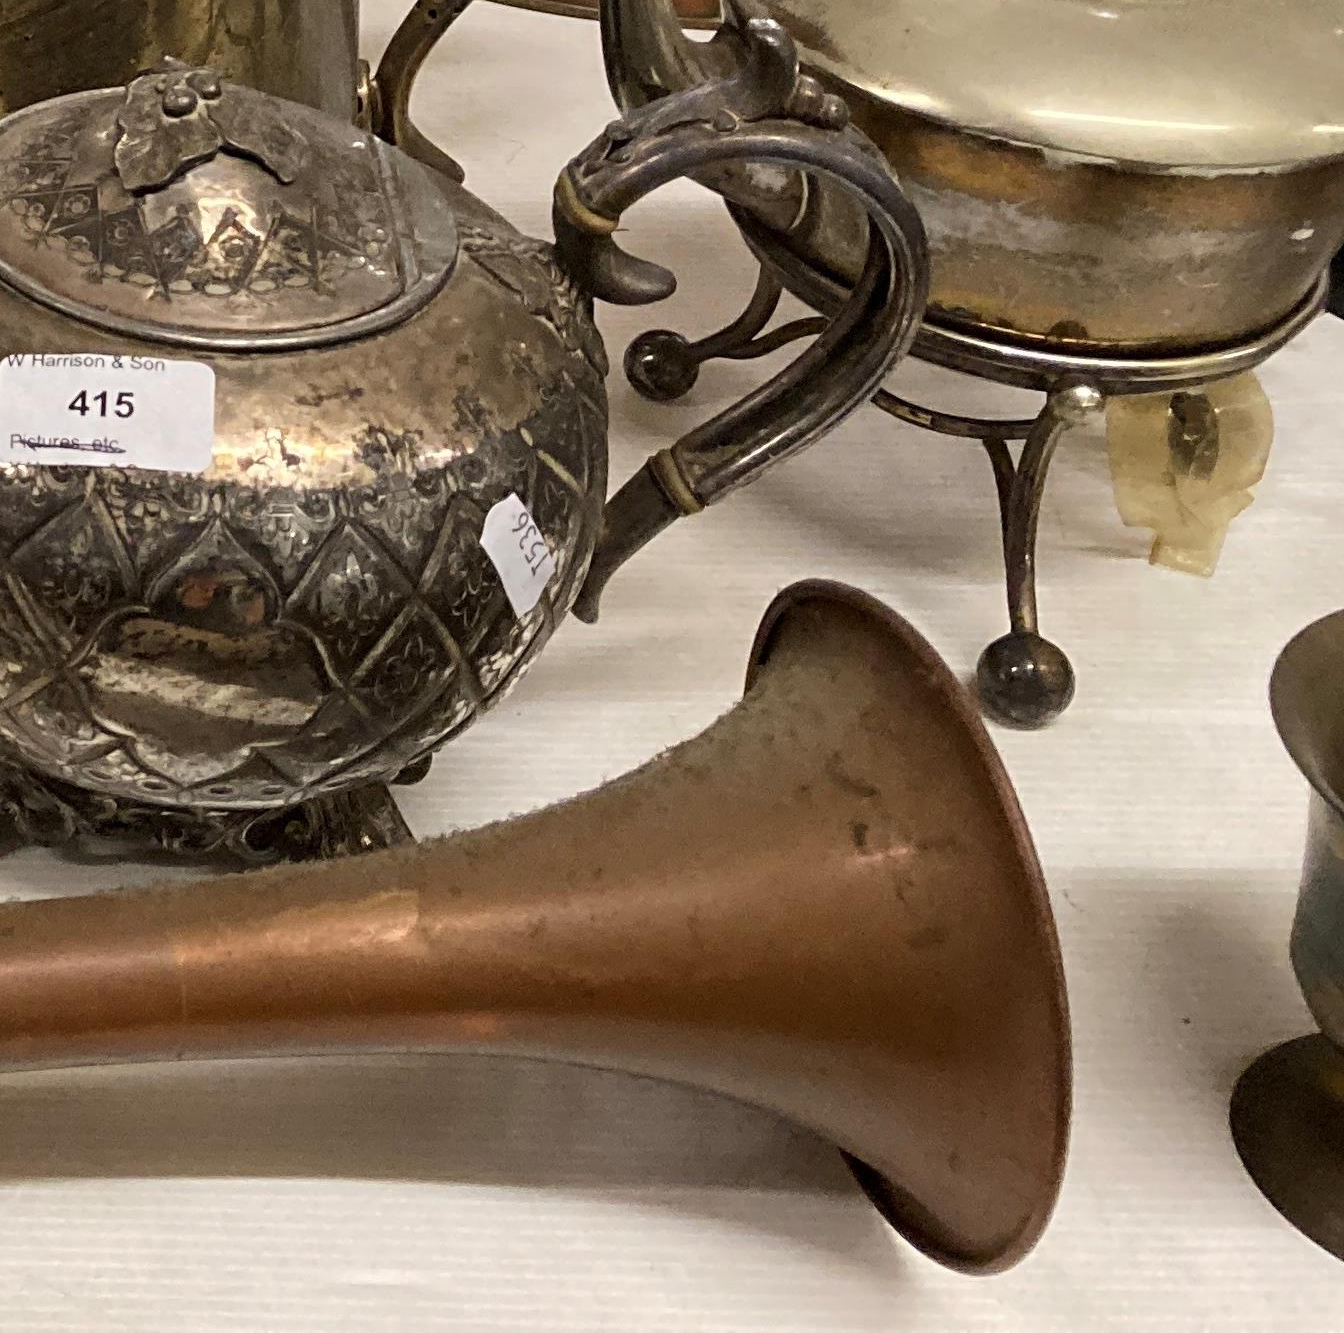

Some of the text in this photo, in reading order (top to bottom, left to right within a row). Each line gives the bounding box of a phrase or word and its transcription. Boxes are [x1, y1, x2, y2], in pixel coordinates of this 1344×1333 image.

[8, 353, 166, 372] W Harrison & Son
[68, 390, 135, 418] 415
[511, 512, 549, 577] T536
